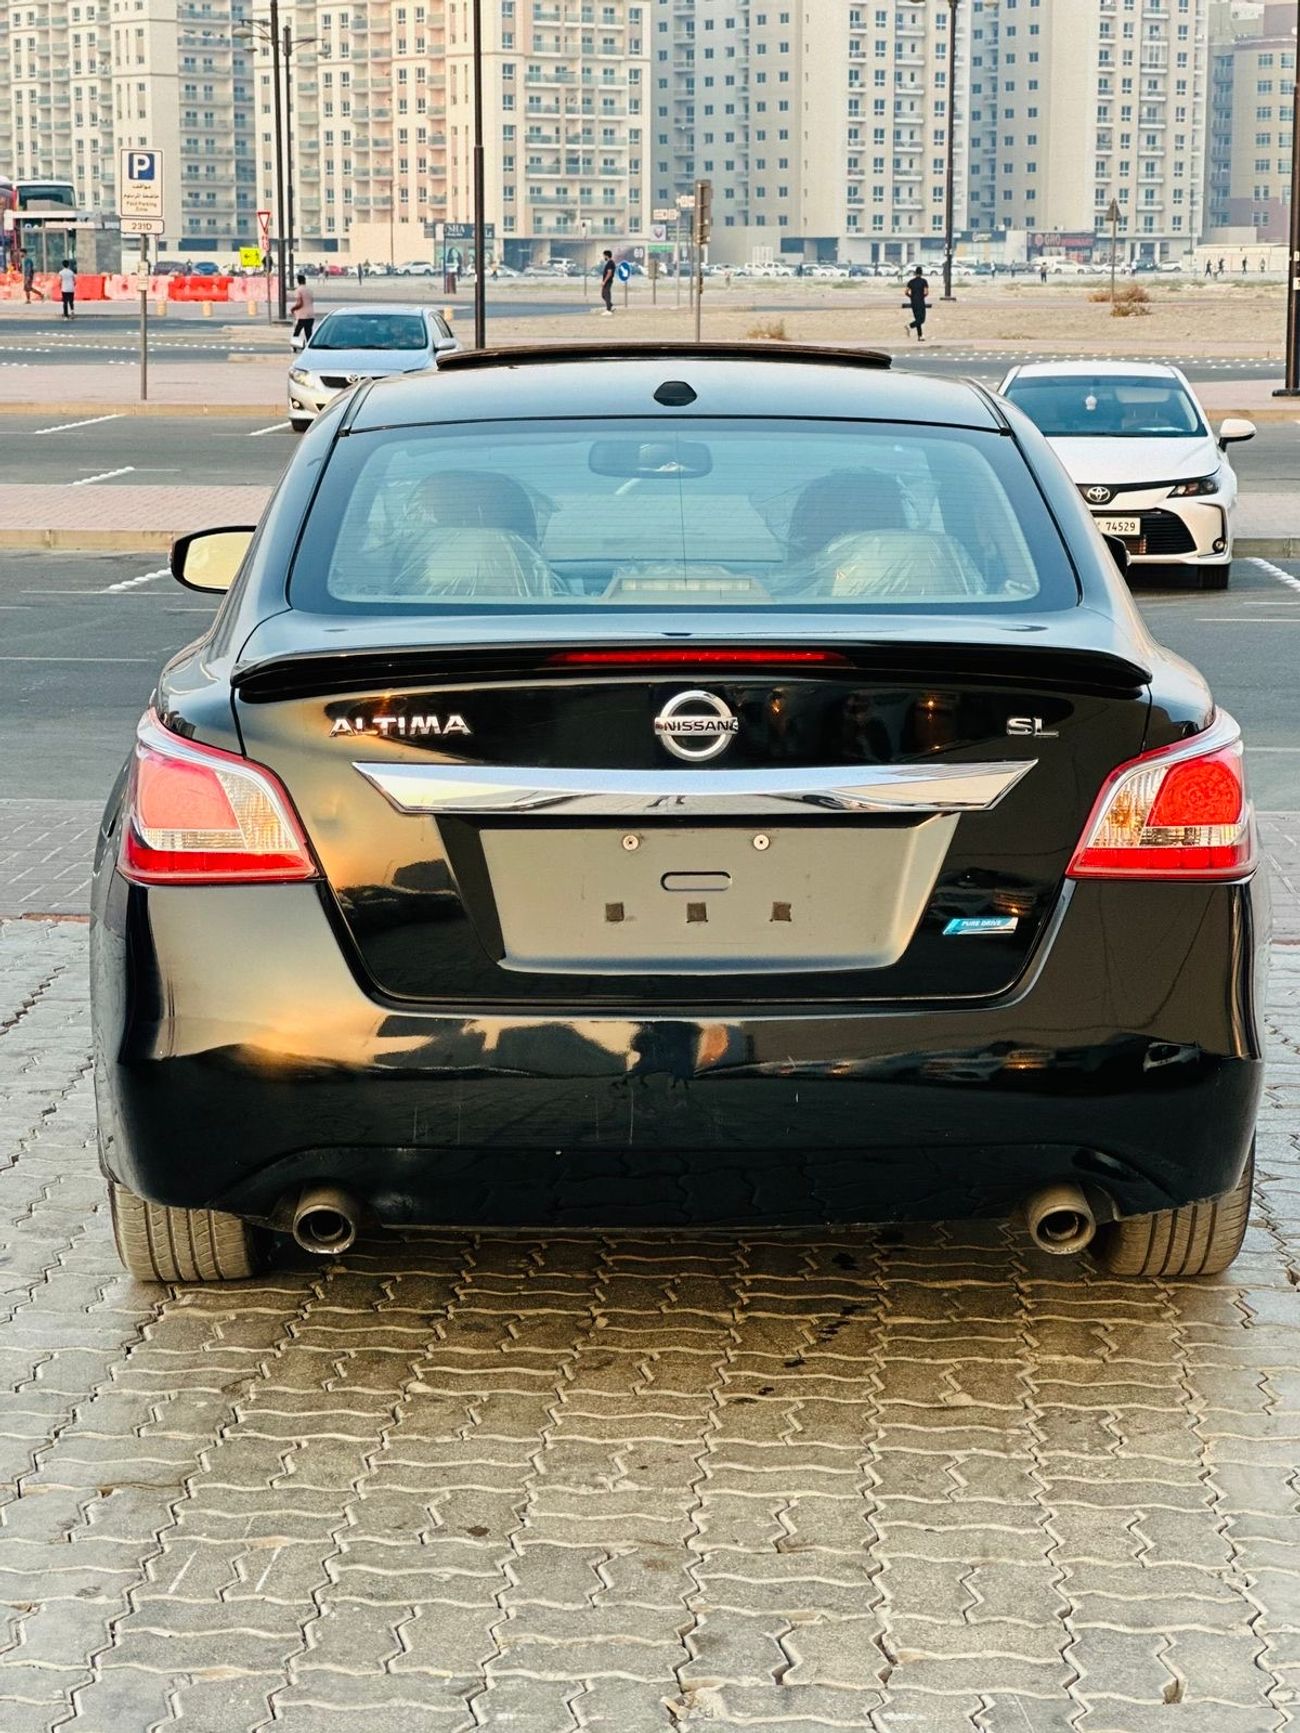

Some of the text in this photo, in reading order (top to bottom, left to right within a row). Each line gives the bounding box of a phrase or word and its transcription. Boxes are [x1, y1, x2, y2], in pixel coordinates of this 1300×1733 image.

[133, 154, 150, 179] P
[131, 222, 153, 231] 231D
[1105, 521, 1136, 532] 74529
[328, 715, 473, 738] ALTIMA
[661, 719, 733, 733] NISSAN
[1006, 717, 1060, 738] SL
